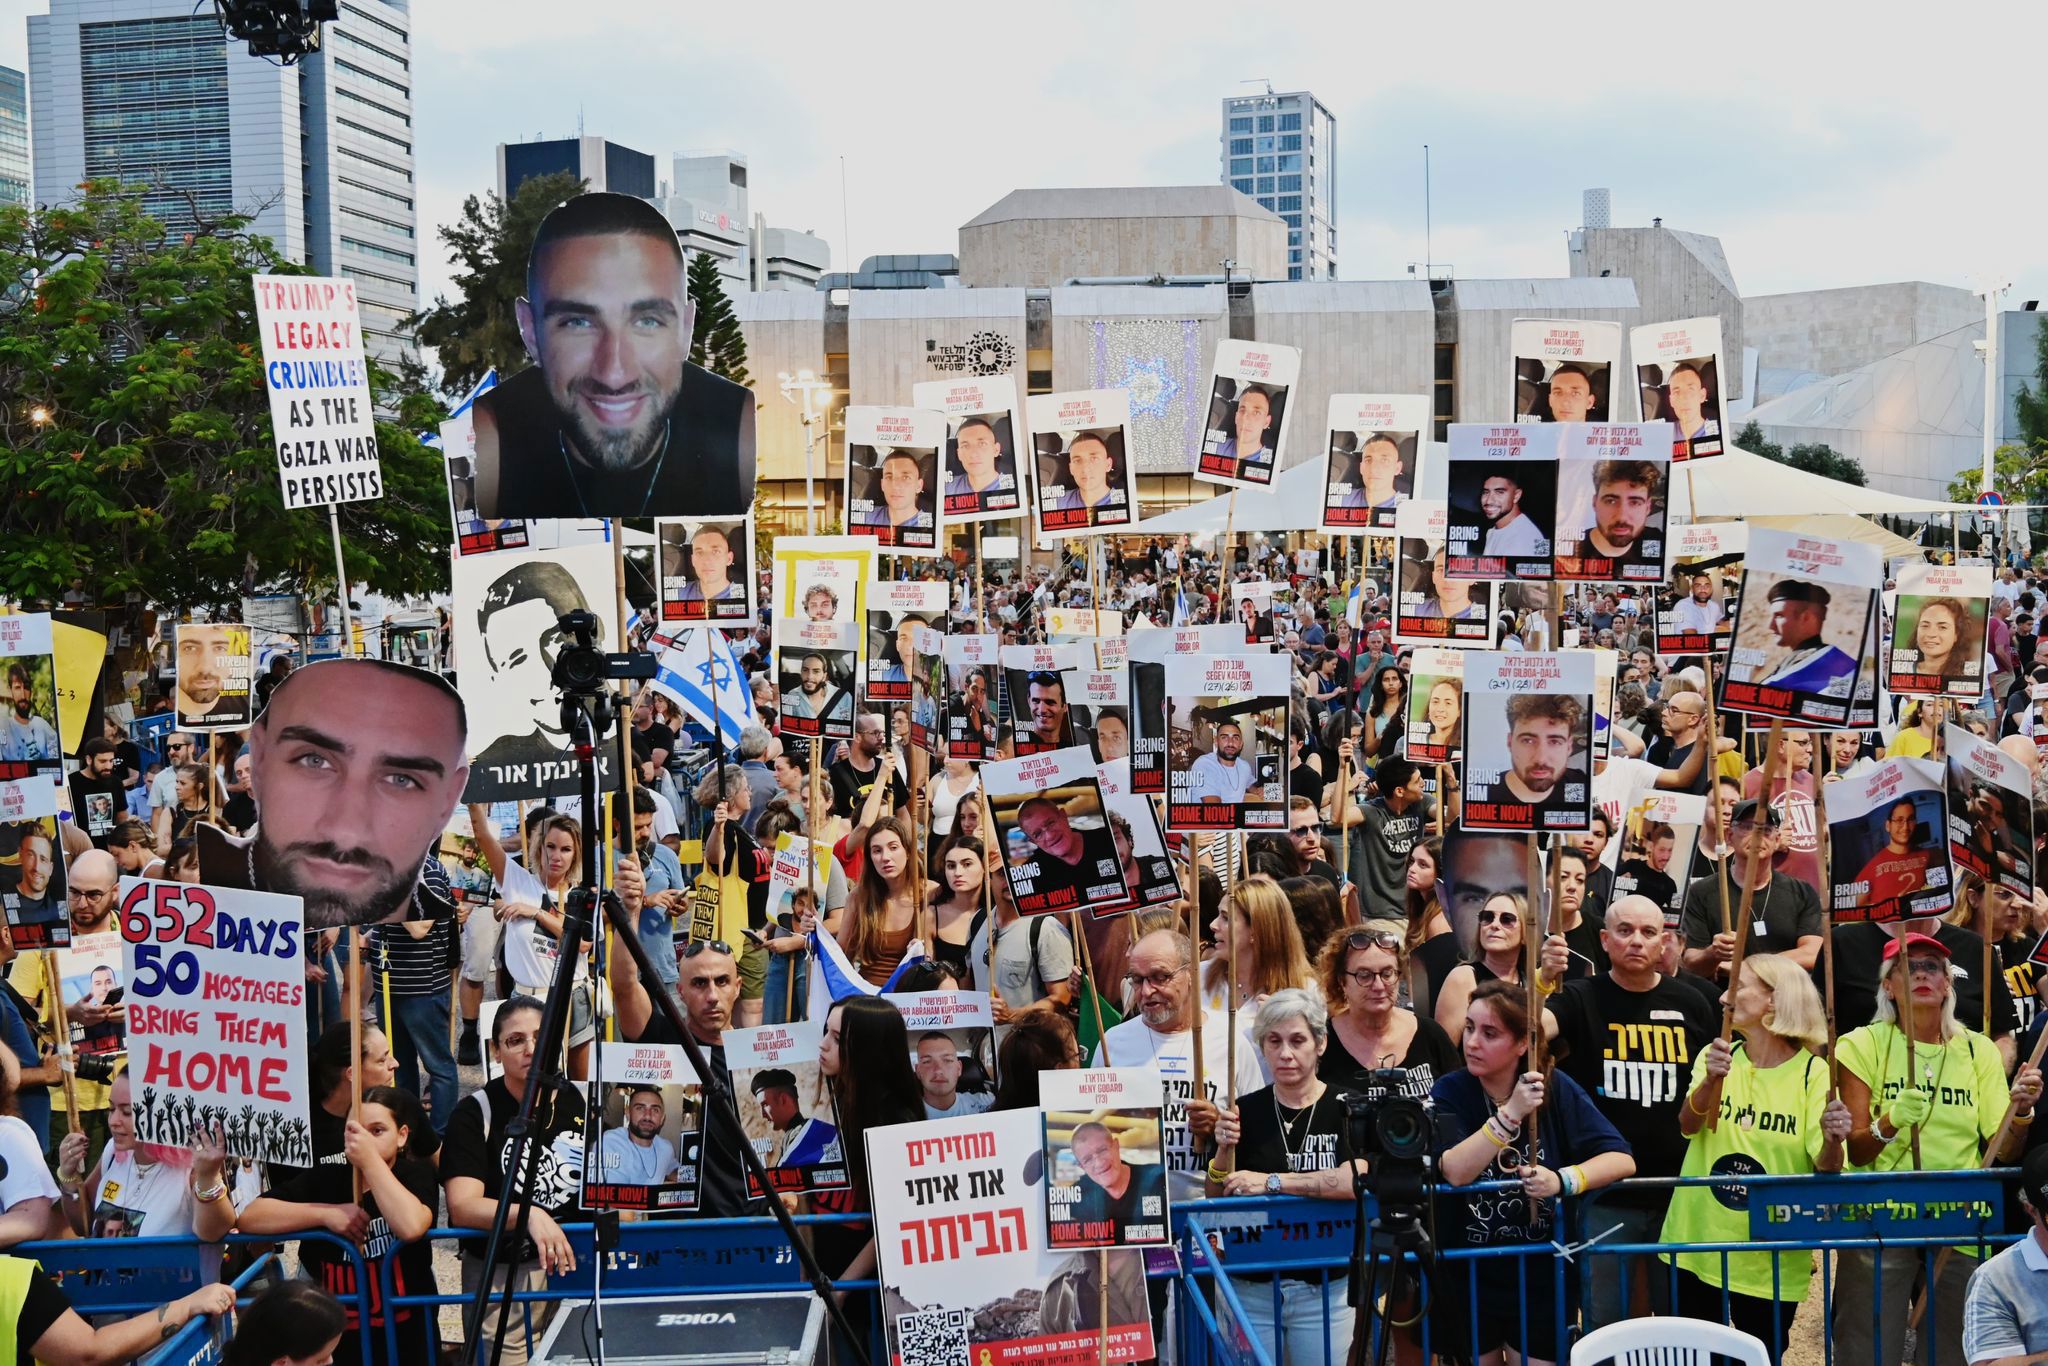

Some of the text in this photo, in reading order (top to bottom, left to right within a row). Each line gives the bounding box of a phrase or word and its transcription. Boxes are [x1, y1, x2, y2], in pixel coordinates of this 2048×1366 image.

[259, 280, 356, 312] TRUMP'S
[273, 321, 352, 350] LEGACY
[1544, 338, 1584, 347] MATAN ANGREST
[939, 346, 953, 354] TEL
[953, 345, 966, 354] תל
[946, 355, 966, 363] אביב
[268, 359, 367, 390] CRUMBLES
[934, 363, 954, 371] YAFO
[954, 363, 966, 371] יפו
[945, 393, 984, 404] MATAN ANGREST
[289, 397, 359, 428] AS THE
[1058, 407, 1097, 418] MATAN ANGREST
[1358, 410, 1375, 418] MATAN
[876, 425, 915, 434] MATAN ANGREST
[1483, 437, 1527, 447] EVYATAR DAVID
[1586, 437, 1599, 446] GUY
[279, 435, 379, 469] GAZA WAR
[286, 470, 380, 507] PERSISTS
[1041, 485, 1065, 499] BRING
[1328, 482, 1352, 495] BRING
[851, 499, 874, 513] BRING
[1449, 526, 1479, 541] BRING
[1555, 526, 1585, 541] BRING
[1698, 535, 1718, 544] KALFON
[1449, 541, 1468, 556] HIM
[1555, 542, 1575, 556] HIM
[1448, 557, 1507, 573] HOME NOW!
[1786, 549, 1843, 566] MATAN ANGREST
[1583, 558, 1613, 574] NOW!
[663, 575, 686, 588] BRING
[1401, 592, 1425, 604] BRING
[1658, 611, 1684, 623] BRING
[225, 629, 248, 656] אל
[1174, 642, 1200, 651] DROR OR
[1659, 635, 1710, 648] HOME NOW!
[1545, 657, 1556, 667] גיא
[1732, 648, 1766, 667] BRING
[1893, 648, 1918, 661] BRING
[868, 658, 890, 671] BRING
[1213, 660, 1244, 671] שגב כלפון
[1206, 671, 1251, 681] SEGEV KALFON
[1498, 667, 1561, 678] GUY GILBOA-DALAL
[1758, 688, 1793, 709] NOW!
[1134, 737, 1165, 753] BRING
[1042, 756, 1052, 766] מני
[1134, 753, 1154, 769] HIM
[489, 756, 609, 788] אינתן אור
[1018, 764, 1060, 781] MENY GODARD
[1134, 770, 1163, 786] HOME
[1171, 771, 1204, 787] BRING
[1467, 768, 1500, 785] BRING
[1034, 779, 1047, 789] (73)
[1171, 787, 1192, 804] HIM
[1466, 785, 1488, 801] HIM
[1171, 804, 1235, 822] HOME NOW!
[1465, 803, 1533, 822] HOME NOW!
[779, 849, 796, 864] אהל
[777, 863, 799, 876] הביתה
[1010, 861, 1041, 881] BRING
[774, 872, 794, 886] בחיים
[1614, 876, 1639, 891] BRING
[1013, 881, 1035, 897] HIM
[1834, 880, 1869, 897] BRING
[1018, 884, 1078, 911] HOME NOW!
[1834, 895, 1857, 909] HIM
[120, 881, 300, 959] 652 DAYS
[695, 904, 714, 922] THEM
[693, 923, 713, 939] HOME
[132, 943, 200, 998] 50
[202, 971, 303, 1007] HOSTAGES
[951, 995, 957, 1004] בר
[911, 1003, 979, 1015] ABRAHAM KUPERSHTEIN
[128, 1003, 288, 1049] BRING THEM
[775, 1029, 786, 1039] מתן
[753, 1039, 795, 1052] MATAN ANGREST
[1603, 1023, 1689, 1064] נחזיר.
[635, 1049, 666, 1060] שגב כלפון
[627, 1058, 671, 1069] SEGEV KALFON
[142, 1042, 292, 1103] HOME
[1084, 1072, 1117, 1083] מני גודארד
[1078, 1083, 1123, 1094] MENY GODARD
[1596, 1059, 1677, 1108] נקום.
[1095, 1094, 1109, 1105] (73)
[1940, 1085, 1973, 1108] אתם
[1759, 1111, 1797, 1136] אתם
[905, 1131, 997, 1168] מחזירים
[1733, 1160, 1751, 1172] אני
[617, 1186, 648, 1202] NOW!
[905, 1168, 1006, 1206] את איתי
[1050, 1186, 1082, 1204] BRING
[1050, 1204, 1071, 1221] HIM
[1922, 1200, 1993, 1220] עיריית
[900, 1207, 1028, 1266] הביתה
[1051, 1218, 1115, 1241] HOME NOW!
[655, 1312, 737, 1327] VOICE
[1045, 1341, 1057, 1351] עוז
[1059, 1338, 1077, 1350] בנחל
[1079, 1336, 1093, 1348] לחם
[1003, 1345, 1021, 1358] לעזה
